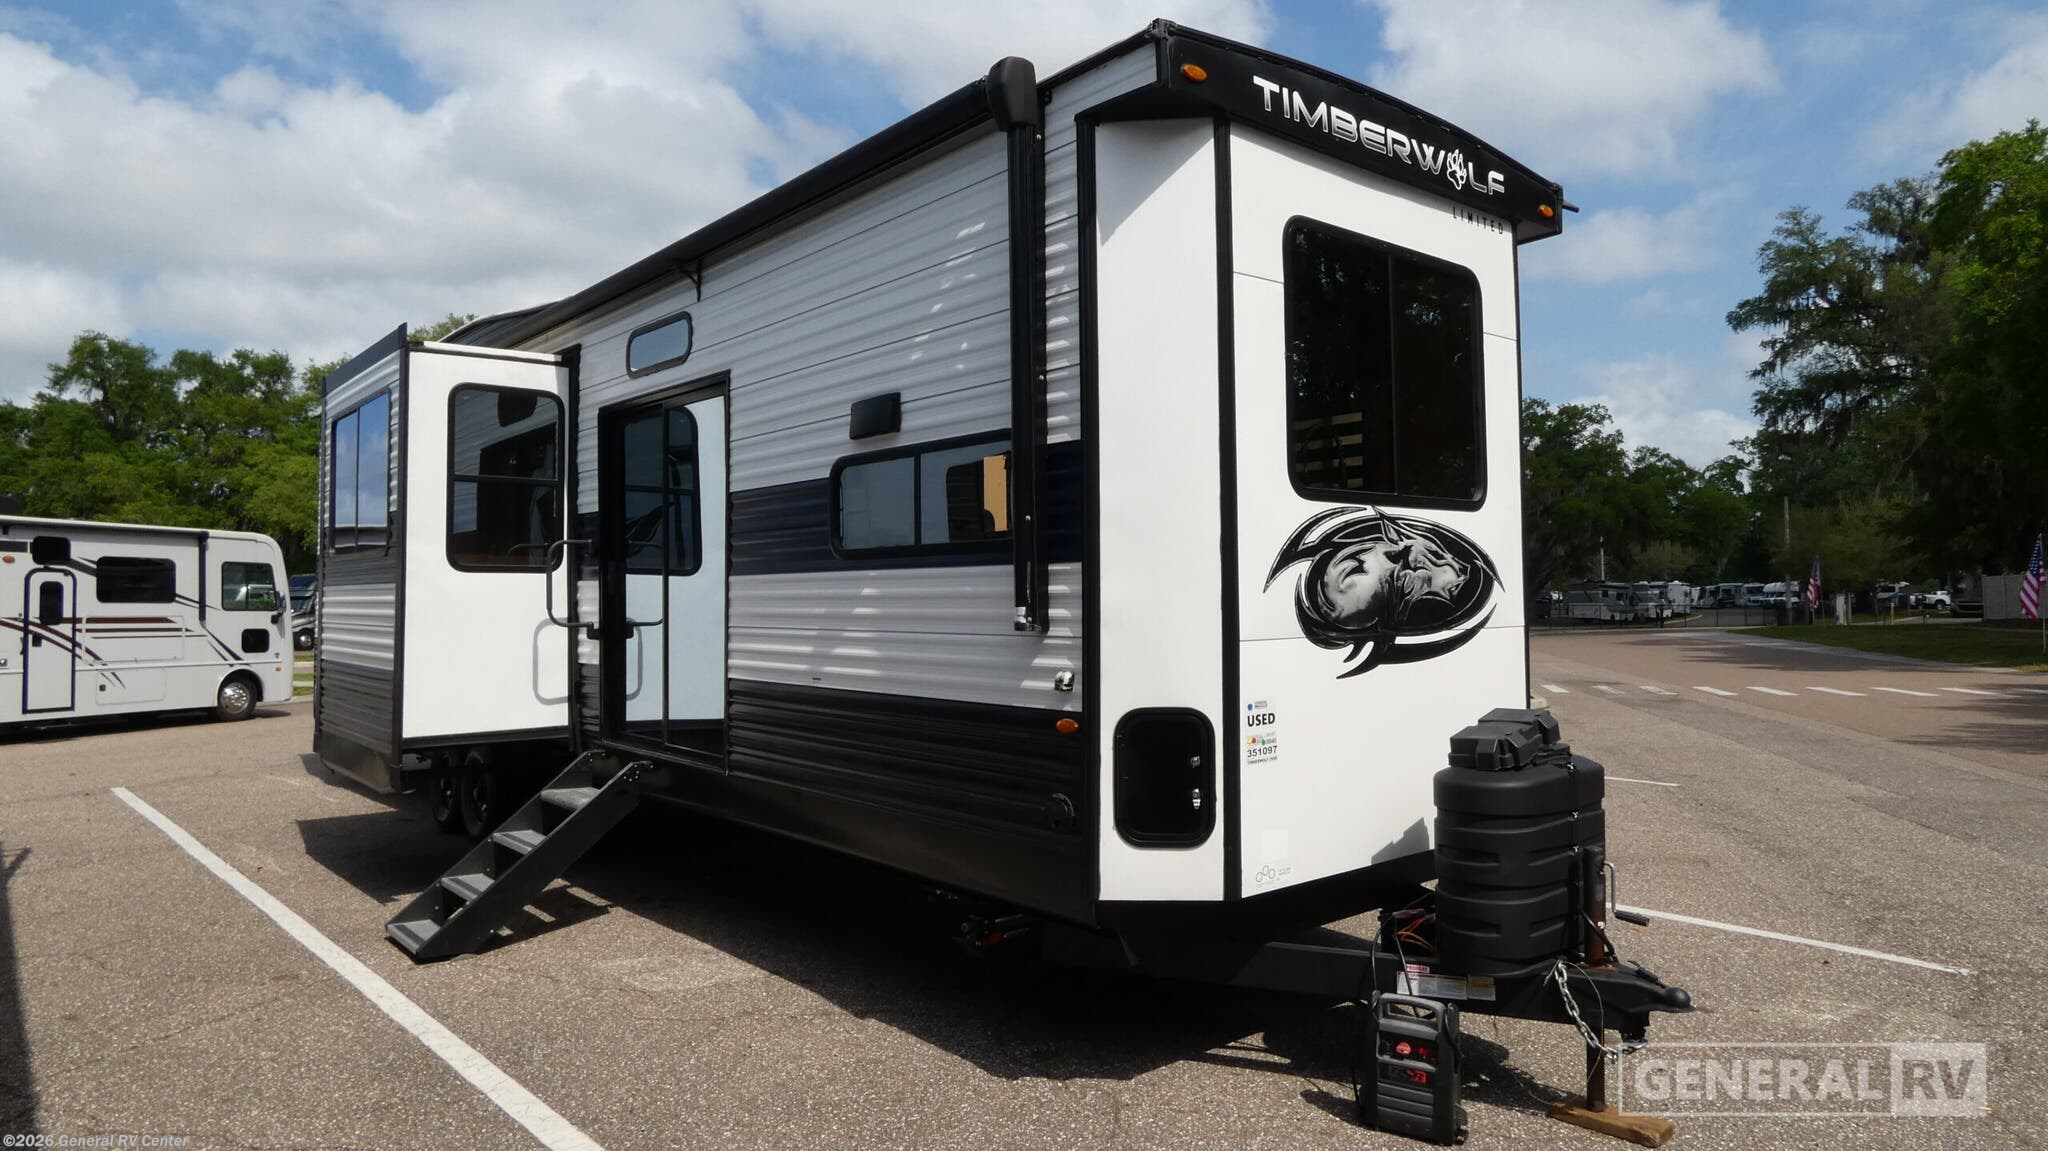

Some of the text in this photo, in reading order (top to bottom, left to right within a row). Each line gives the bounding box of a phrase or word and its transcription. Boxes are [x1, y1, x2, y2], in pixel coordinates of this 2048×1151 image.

[1452, 205, 1505, 235] LIMITED
[1247, 712, 1276, 728] USED
[1247, 745, 1278, 758] 351097
